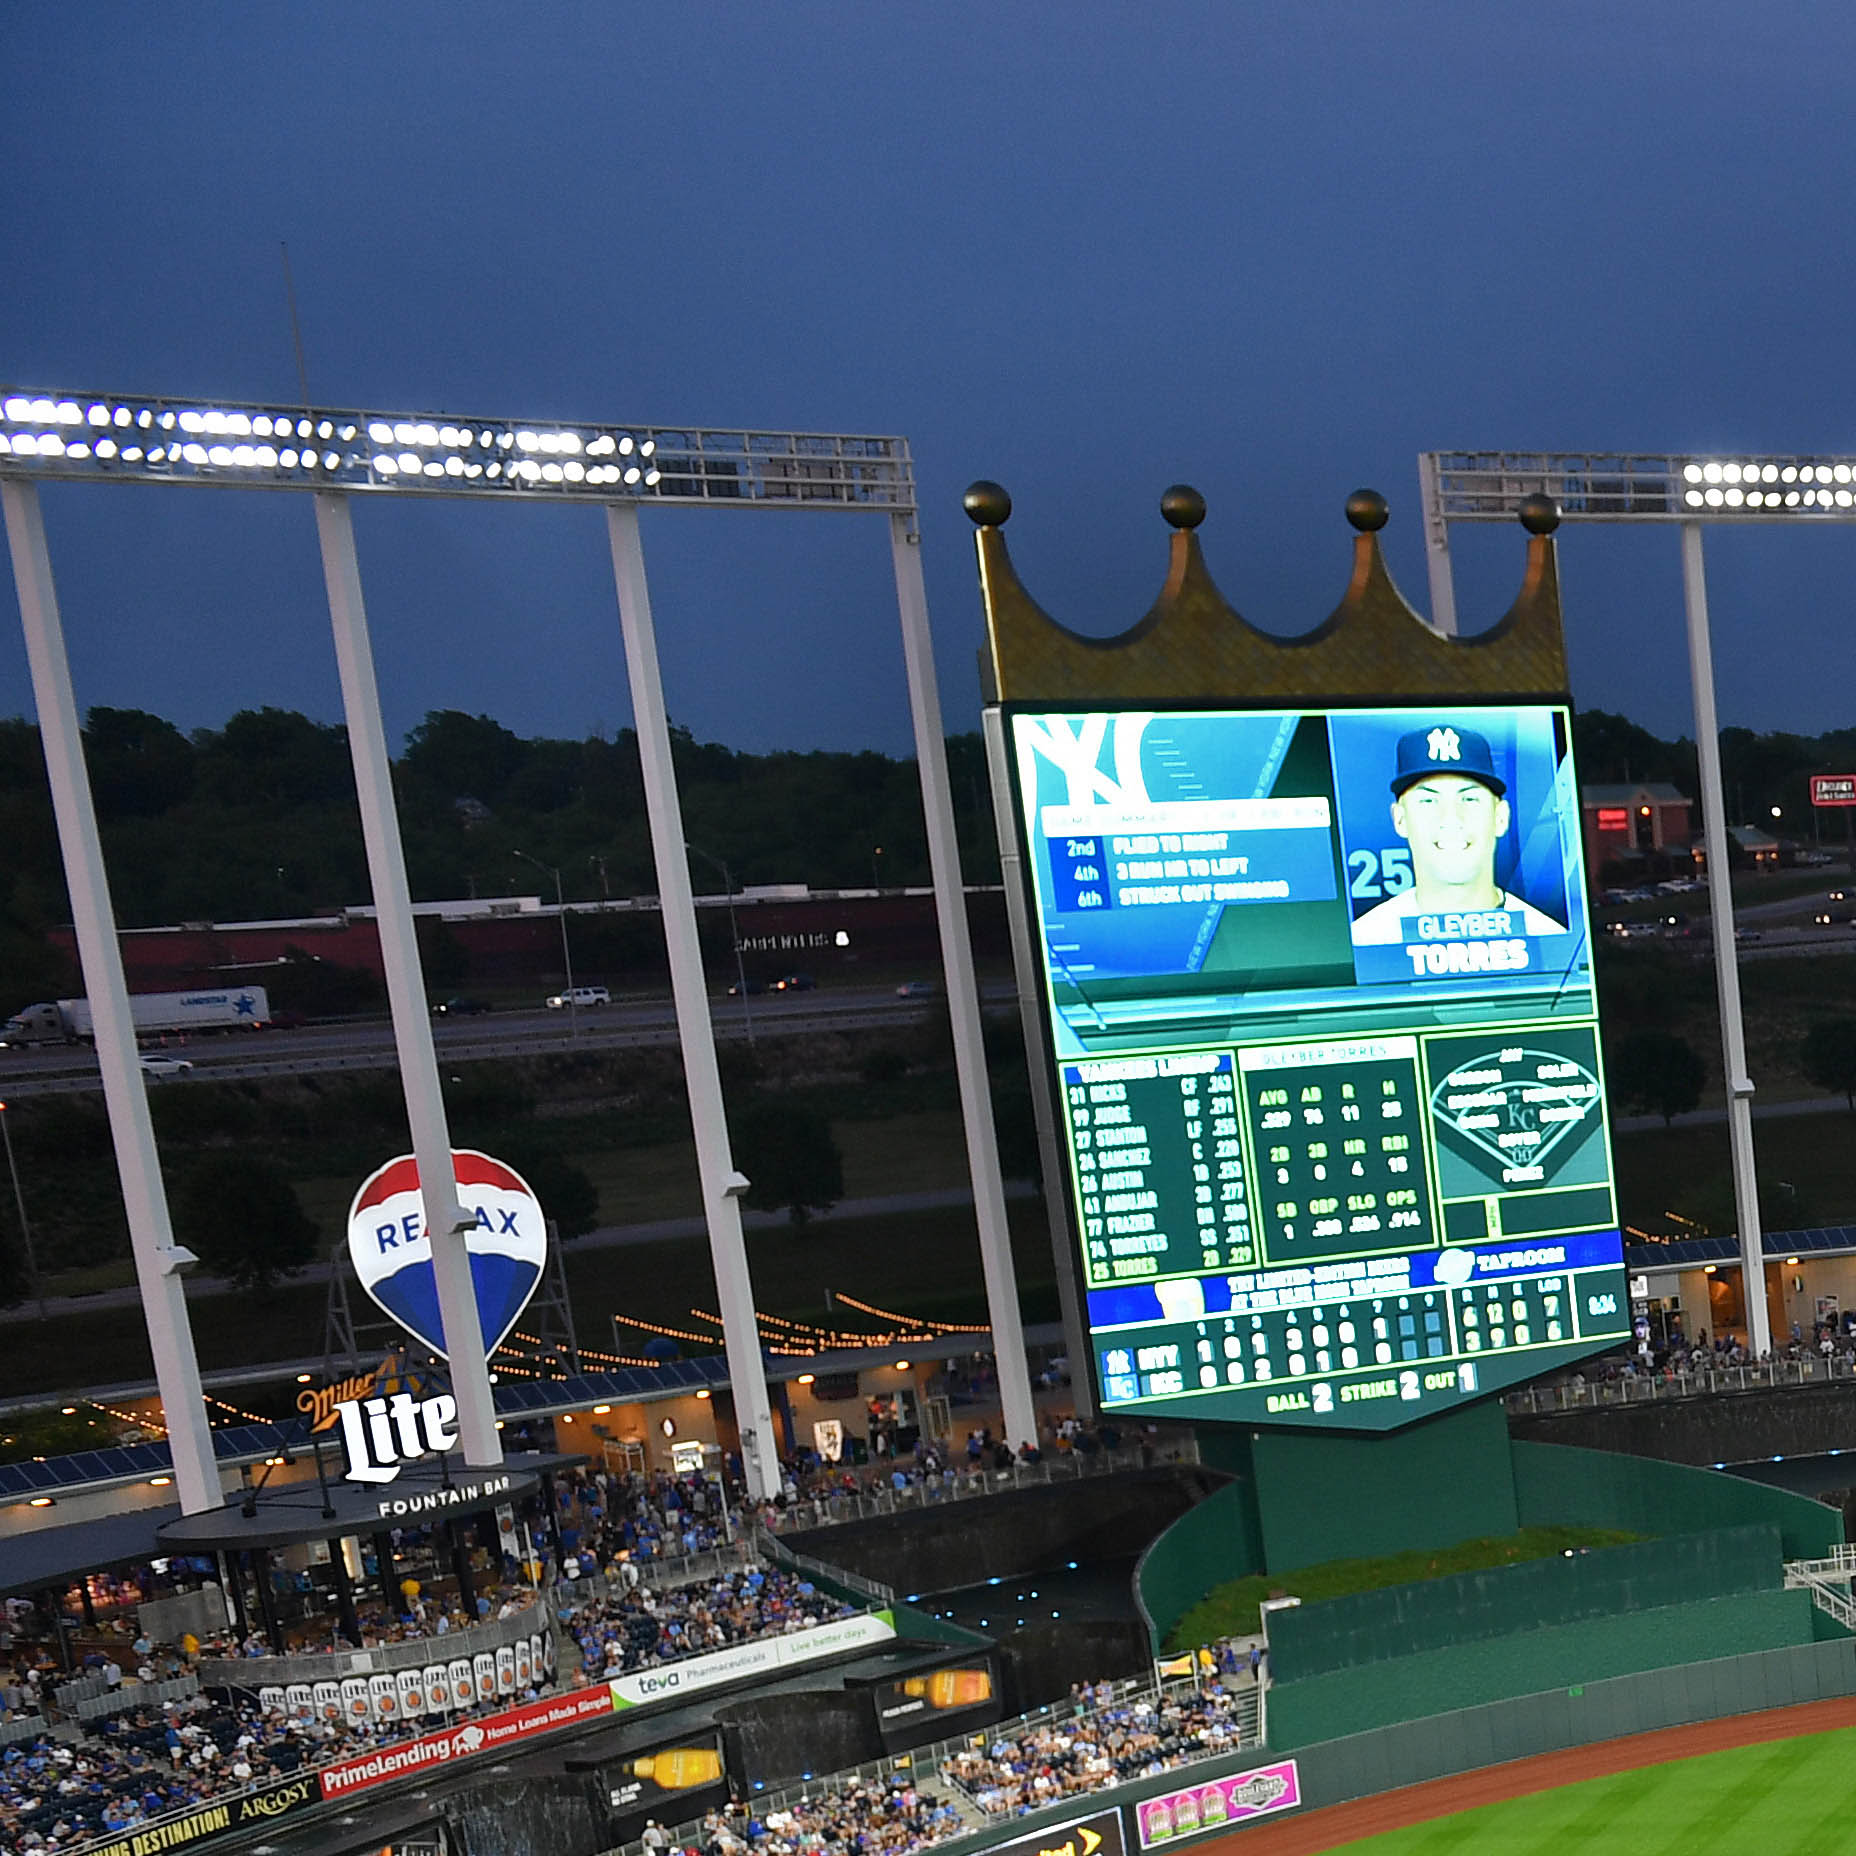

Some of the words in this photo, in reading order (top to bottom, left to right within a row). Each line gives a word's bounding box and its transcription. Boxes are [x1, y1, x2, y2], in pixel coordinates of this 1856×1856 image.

[1067, 839, 1096, 856] 2nd
[1074, 865, 1099, 881] 4th
[1348, 849, 1415, 898] 25
[1078, 891, 1102, 907] 6th
[1416, 912, 1512, 940] GLEYBER
[1406, 938, 1530, 977] TORRES
[1260, 1089, 1289, 1106] AVG
[1301, 1086, 1323, 1102] AB
[1341, 1105, 1359, 1121] 11
[1347, 1193, 1377, 1211] SLG
[1386, 1189, 1417, 1206] OPS
[376, 1206, 520, 1254] REAX
[1477, 1246, 1566, 1272] TAPROOM
[1286, 1310, 1298, 1325] 4
[1486, 1302, 1504, 1325] 12
[1543, 1295, 1559, 1317] 7
[1137, 1343, 1180, 1372] NYY
[1197, 1339, 1213, 1363] 1
[1223, 1335, 1241, 1359] 0
[1251, 1332, 1268, 1355] 1
[1286, 1328, 1304, 1351] 3
[1312, 1324, 1330, 1348] 0
[1338, 1321, 1356, 1344] 0
[1372, 1317, 1388, 1339] 1
[1465, 1330, 1481, 1352] 3
[1200, 1365, 1218, 1389] 0
[1227, 1361, 1245, 1385] 0
[1254, 1358, 1273, 1381] 2
[1288, 1353, 1306, 1376] 0
[1341, 1346, 1359, 1369] 0
[1375, 1342, 1392, 1364] 0
[296, 1371, 377, 1434] Miller
[1266, 1392, 1310, 1415] BALL
[1311, 1382, 1333, 1413] 2
[1339, 1378, 1398, 1404] STRIKE
[1399, 1370, 1421, 1401] 2
[1424, 1371, 1457, 1391] OUT
[1457, 1361, 1478, 1392] 1
[332, 1393, 459, 1484] Lite
[379, 1483, 479, 1518] FOUNTAIN
[484, 1475, 510, 1496] BAR
[686, 1651, 766, 1680] Pharmaceuticals
[790, 1641, 812, 1655] Live
[812, 1633, 842, 1651] better
[843, 1626, 868, 1645] days
[638, 1671, 681, 1695] teva
[323, 1737, 453, 1791] PrimeLending
[487, 1721, 519, 1741] Home
[519, 1714, 549, 1731] Loans
[549, 1704, 578, 1723] Made
[578, 1694, 611, 1715] Simple
[239, 1780, 311, 1820] ARGOSY
